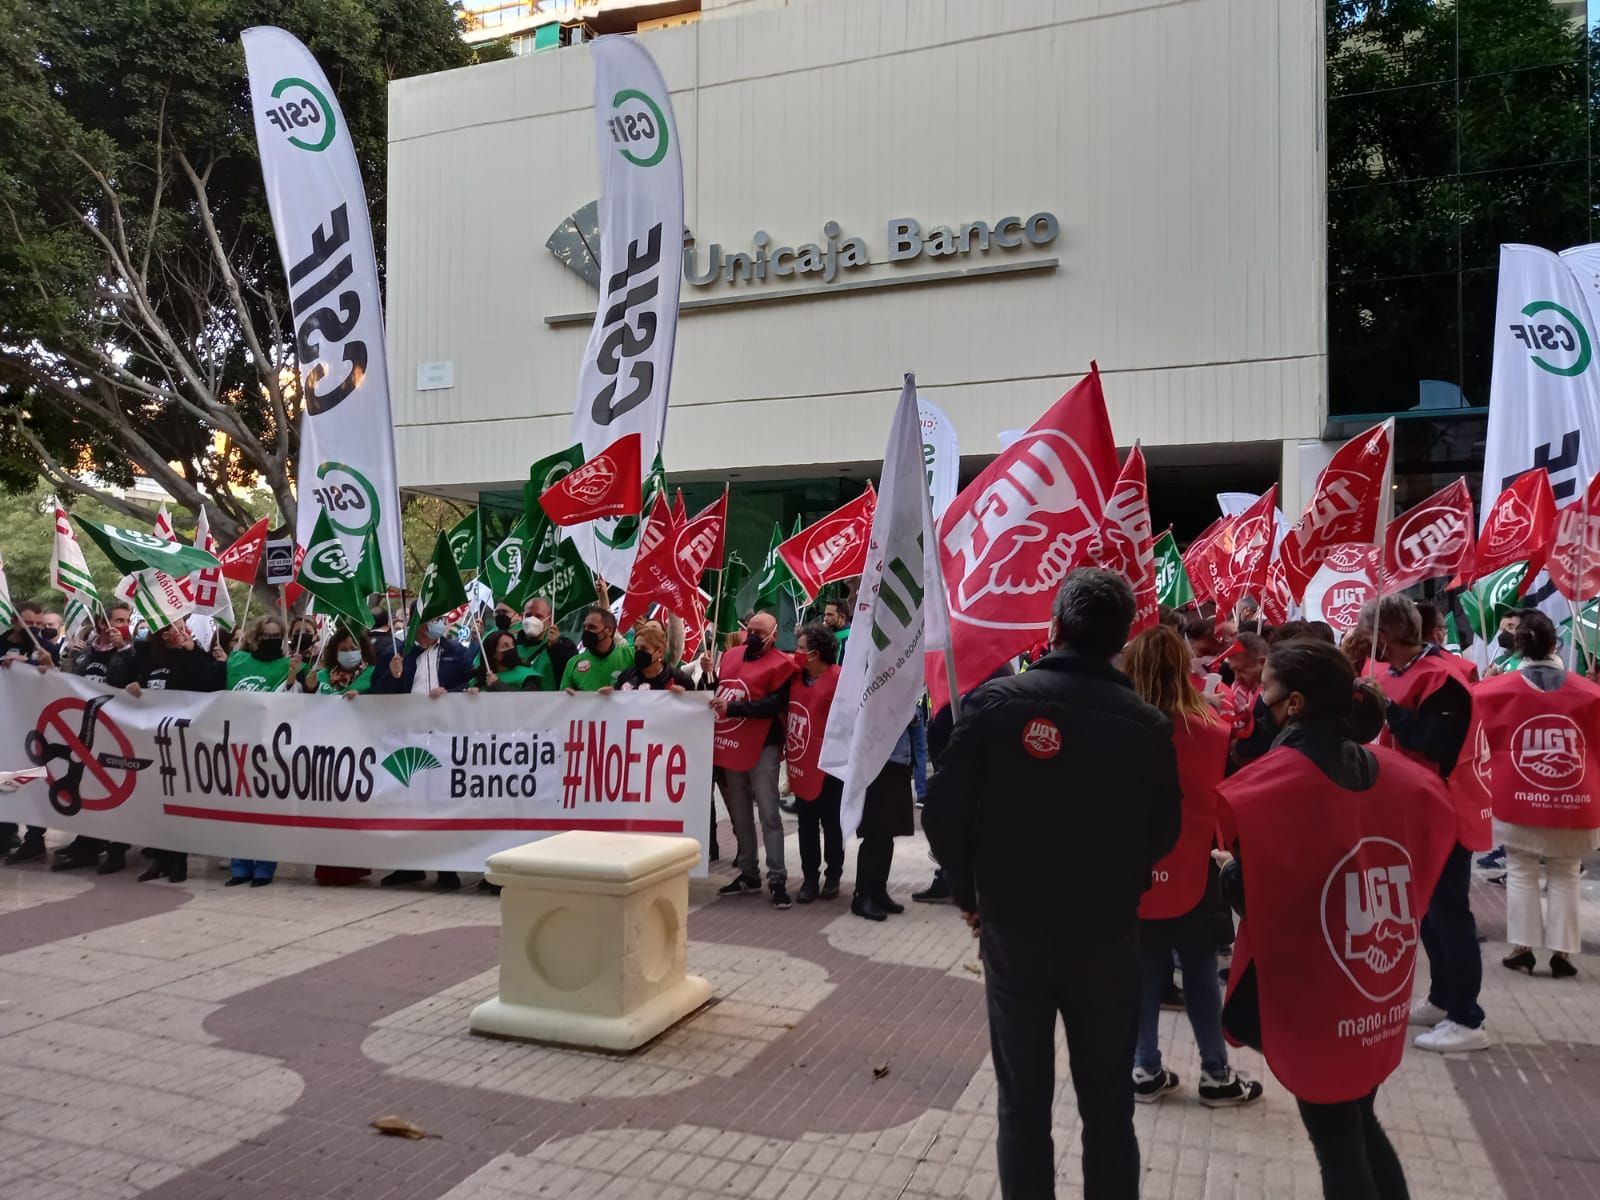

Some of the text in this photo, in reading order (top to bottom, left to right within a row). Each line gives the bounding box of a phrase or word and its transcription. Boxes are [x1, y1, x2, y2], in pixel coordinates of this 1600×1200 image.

[683, 211, 1059, 285] Unicaja Banco
[809, 523, 858, 572] UGT
[154, 570, 183, 610] Málaga
[1333, 587, 1366, 607] UGT
[1029, 720, 1058, 742] UGT
[1521, 728, 1579, 757] UGT
[154, 716, 376, 802] #TodxsSomos
[451, 734, 556, 772] Unicaja
[562, 719, 686, 809] #NoEre
[450, 768, 537, 799] Banco
[1515, 792, 1550, 802] mano
[1345, 865, 1411, 934] UGT
[1338, 1012, 1381, 1038] mano
